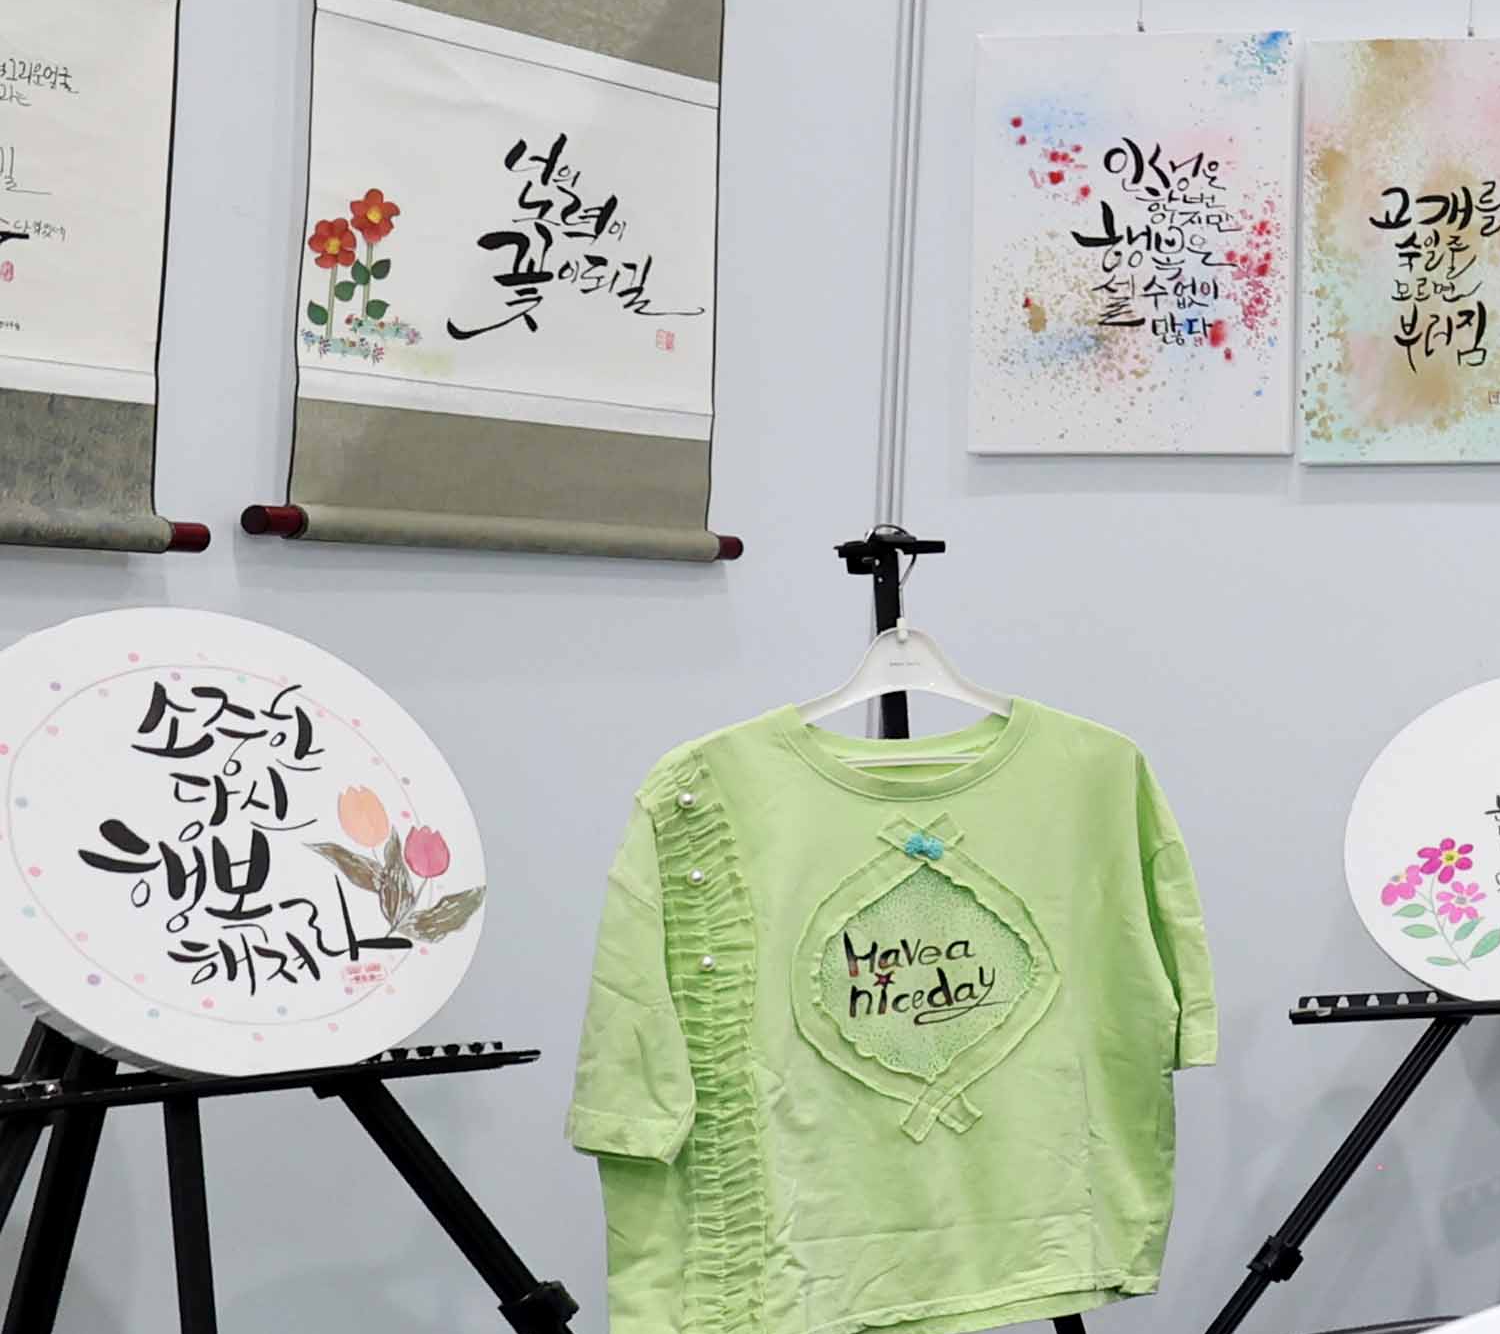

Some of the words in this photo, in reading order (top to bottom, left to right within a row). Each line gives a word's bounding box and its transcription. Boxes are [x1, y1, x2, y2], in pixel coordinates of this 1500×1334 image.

[504, 133, 581, 187] 너의
[1103, 137, 1226, 193] 인생은
[512, 180, 626, 244] 노력이
[1070, 200, 1239, 281] 행복은
[1391, 277, 1483, 303] 모르면
[1151, 313, 1216, 347] 많다
[1394, 301, 1487, 374] 부러짐
[131, 681, 326, 777] 소중한
[78, 817, 273, 944] 행복
